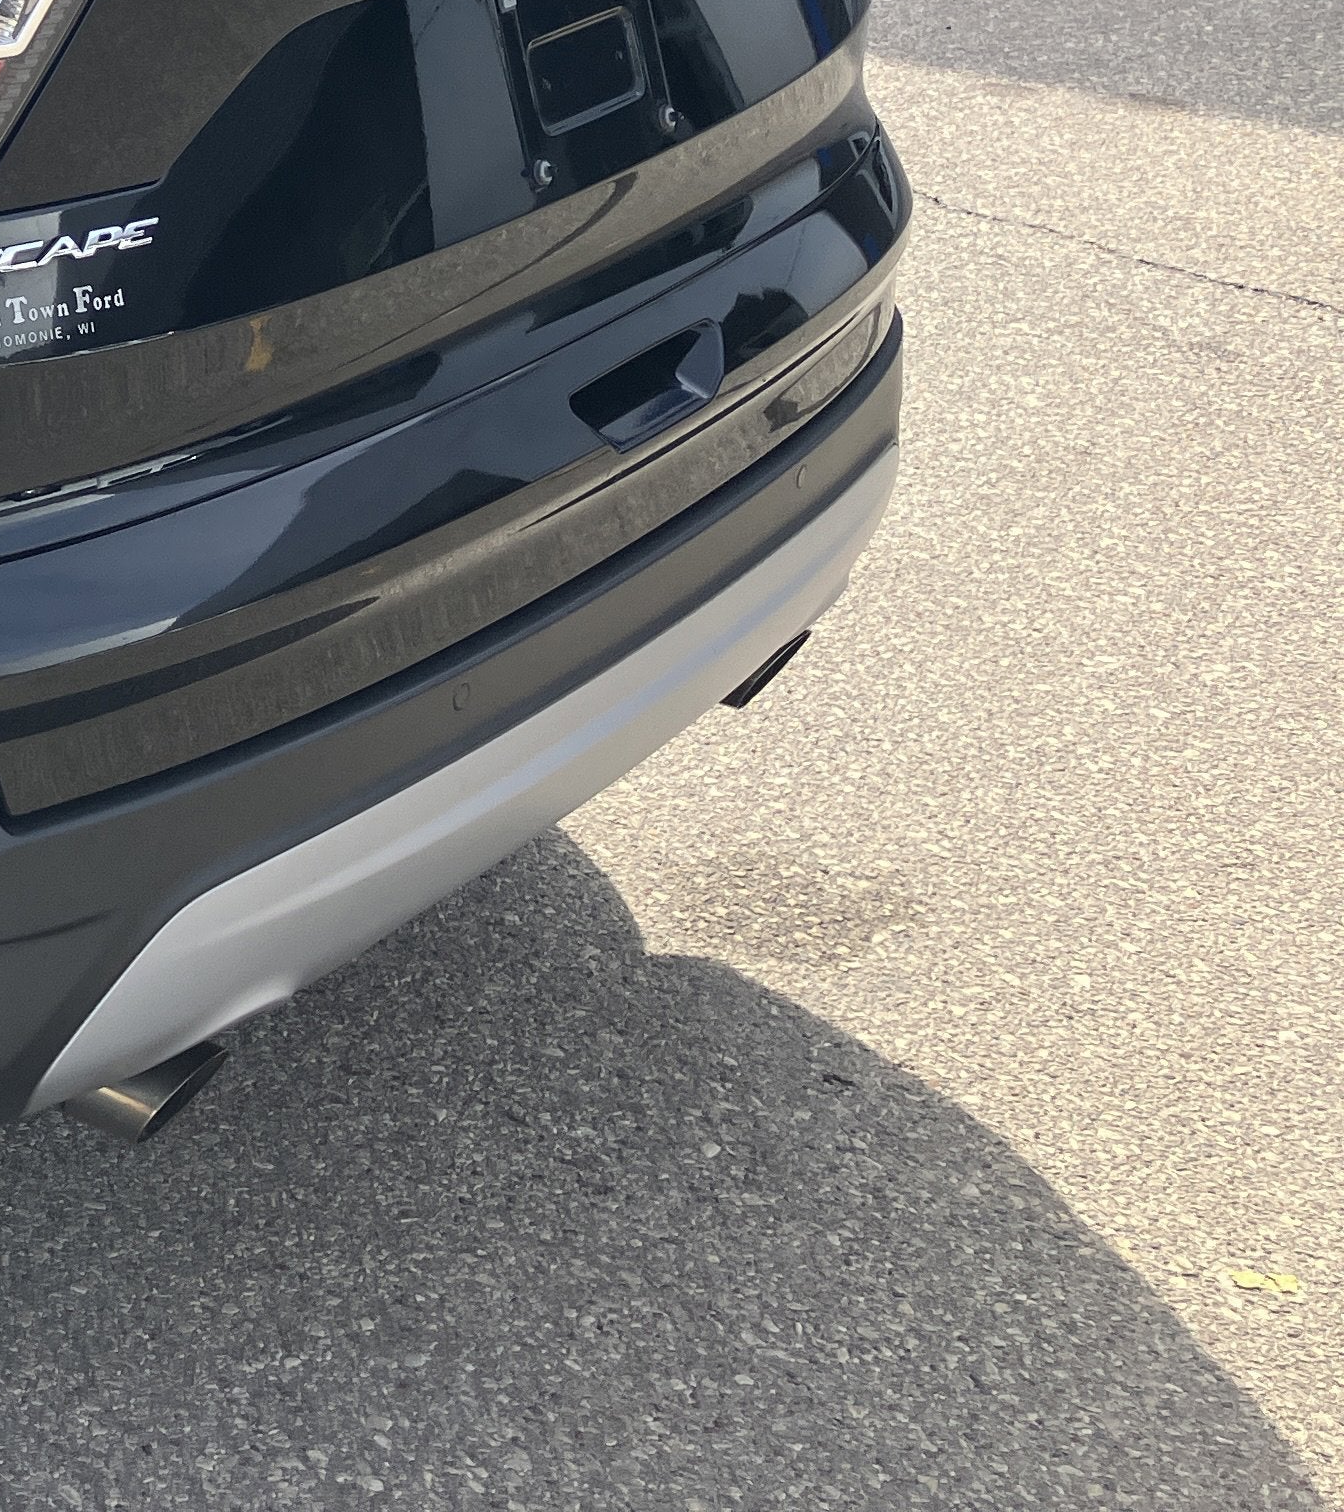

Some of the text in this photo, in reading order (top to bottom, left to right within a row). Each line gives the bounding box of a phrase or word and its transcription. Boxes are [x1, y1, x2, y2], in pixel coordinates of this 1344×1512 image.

[5, 296, 70, 324] Town
[73, 285, 125, 313] Ford
[77, 321, 95, 336] WI
